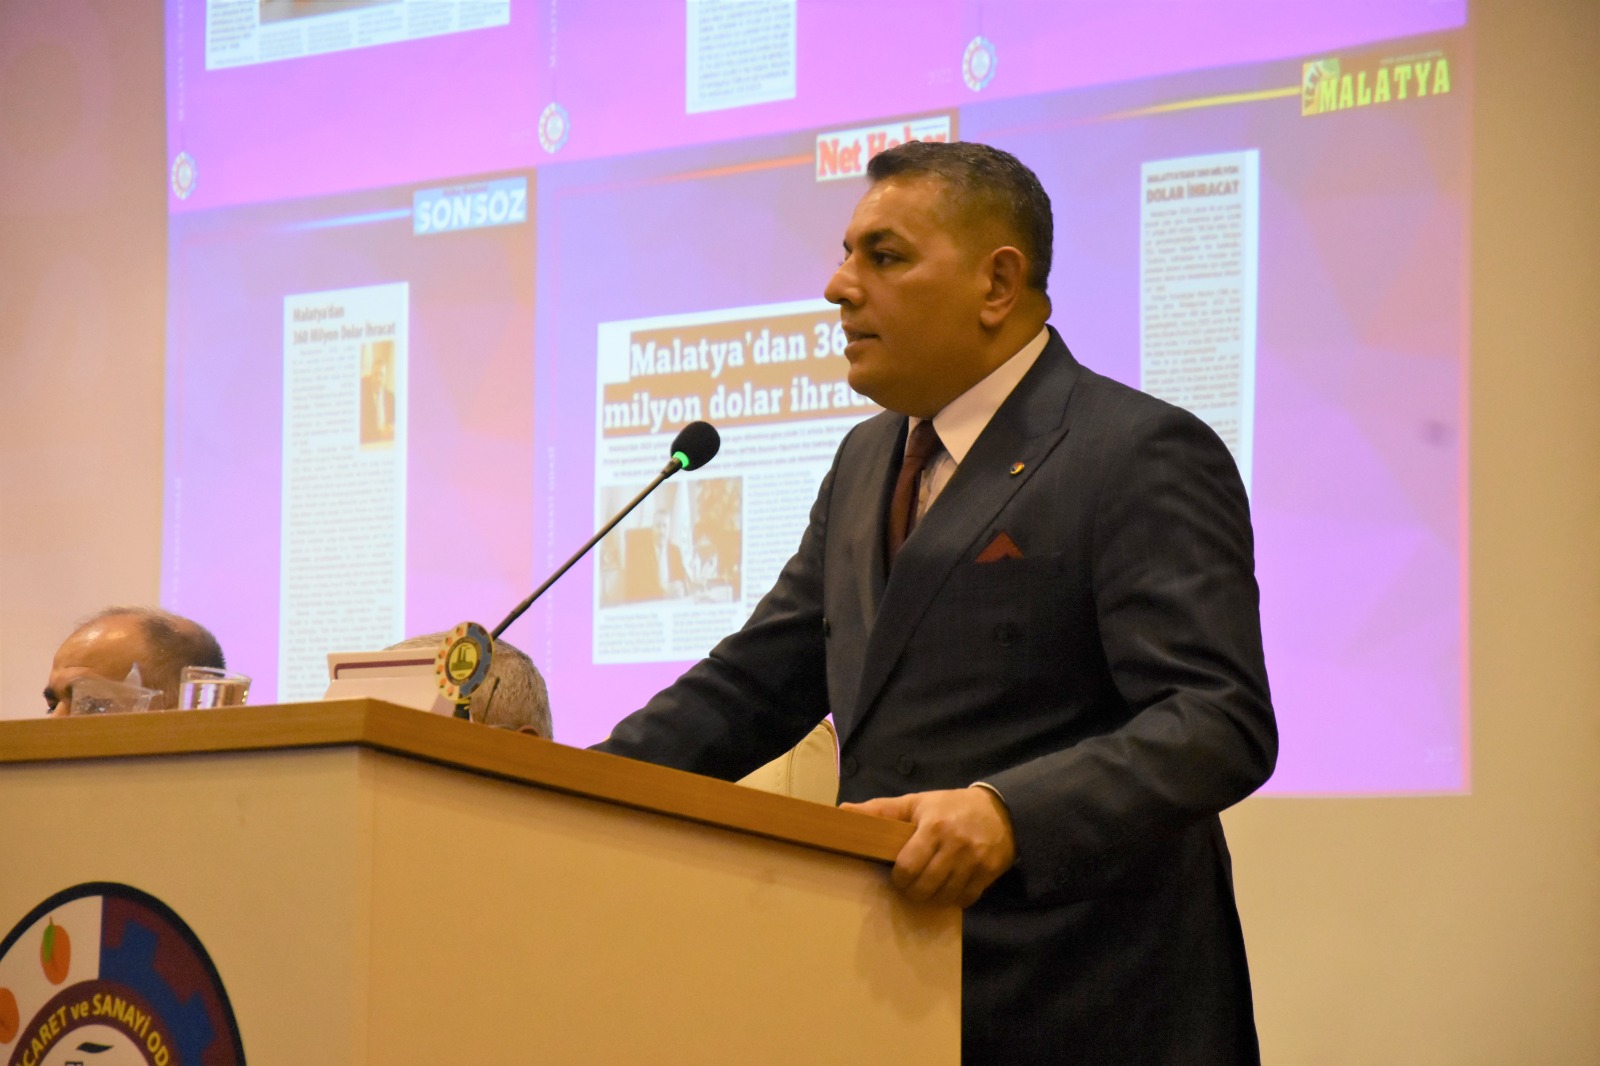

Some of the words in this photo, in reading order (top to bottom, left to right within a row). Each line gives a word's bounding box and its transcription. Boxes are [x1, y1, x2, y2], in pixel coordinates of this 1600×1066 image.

[1319, 58, 1450, 114] MALATYA
[817, 137, 862, 178] Net
[1146, 185, 1185, 204] DOLAR
[630, 328, 807, 379] Malatya'dan
[602, 391, 703, 434] milyon
[708, 381, 784, 421] dolar
[790, 375, 876, 413] ihrac
[18, 1005, 68, 1066] CARET
[70, 1000, 91, 1021] ve
[146, 1030, 172, 1066] OD
